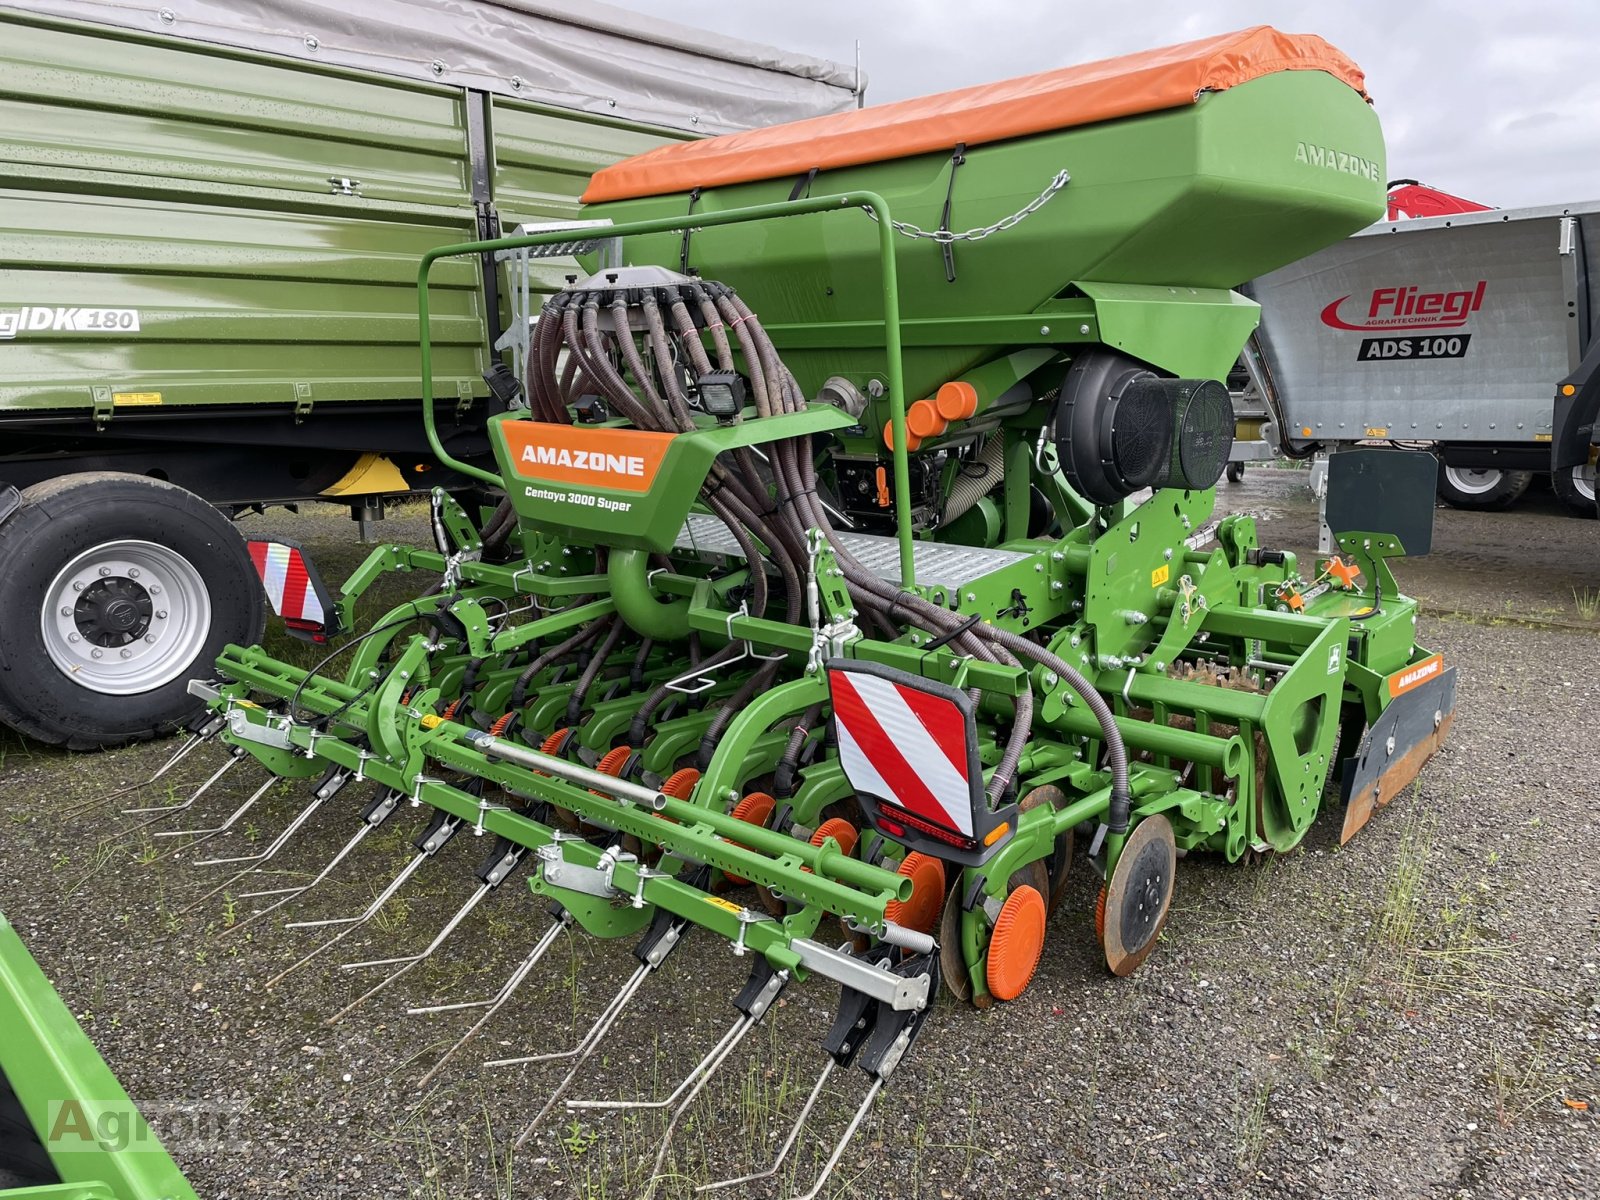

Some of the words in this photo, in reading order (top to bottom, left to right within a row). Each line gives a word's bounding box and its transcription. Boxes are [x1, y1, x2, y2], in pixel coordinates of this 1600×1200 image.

[1295, 141, 1380, 182] AMAZONE
[1368, 280, 1487, 321] Fliegl
[87, 311, 133, 329] 180
[1365, 316, 1439, 326] AGRARTECHNIK
[1367, 340, 1413, 358] ADS
[1419, 338, 1461, 356] 100
[521, 444, 644, 477] AMAZONE
[525, 486, 566, 503] Centaya
[567, 492, 595, 507] 3000
[597, 497, 632, 512] Super
[1398, 660, 1439, 689] AMAZONE
